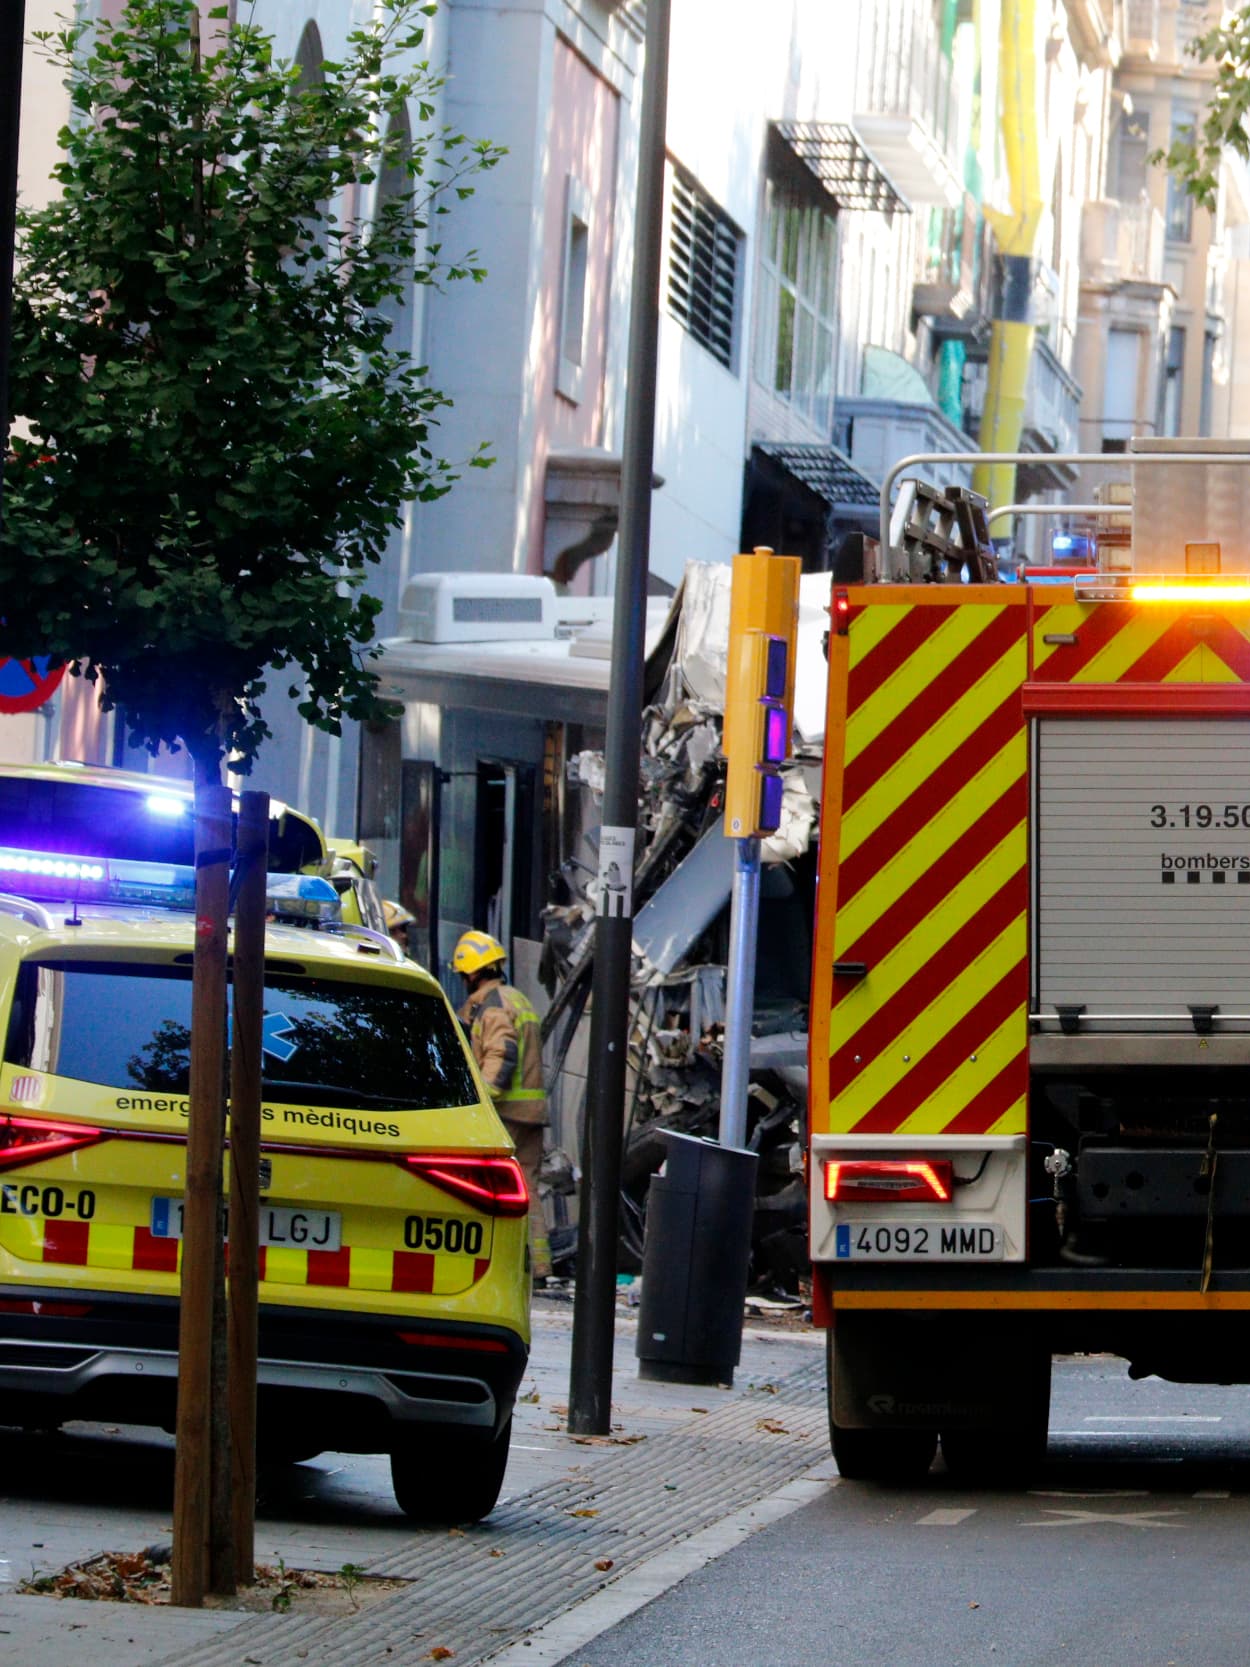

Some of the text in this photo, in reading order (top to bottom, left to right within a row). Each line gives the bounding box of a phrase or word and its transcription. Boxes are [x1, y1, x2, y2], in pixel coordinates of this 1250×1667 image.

[1161, 853, 1250, 869] bombers
[284, 1109, 400, 1137] mèdiques
[1, 1184, 96, 1219] ECO-0
[269, 1211, 331, 1245] LGJ
[404, 1216, 483, 1255] 0500
[857, 1227, 929, 1254] 4092
[941, 1228, 995, 1254] MMD
